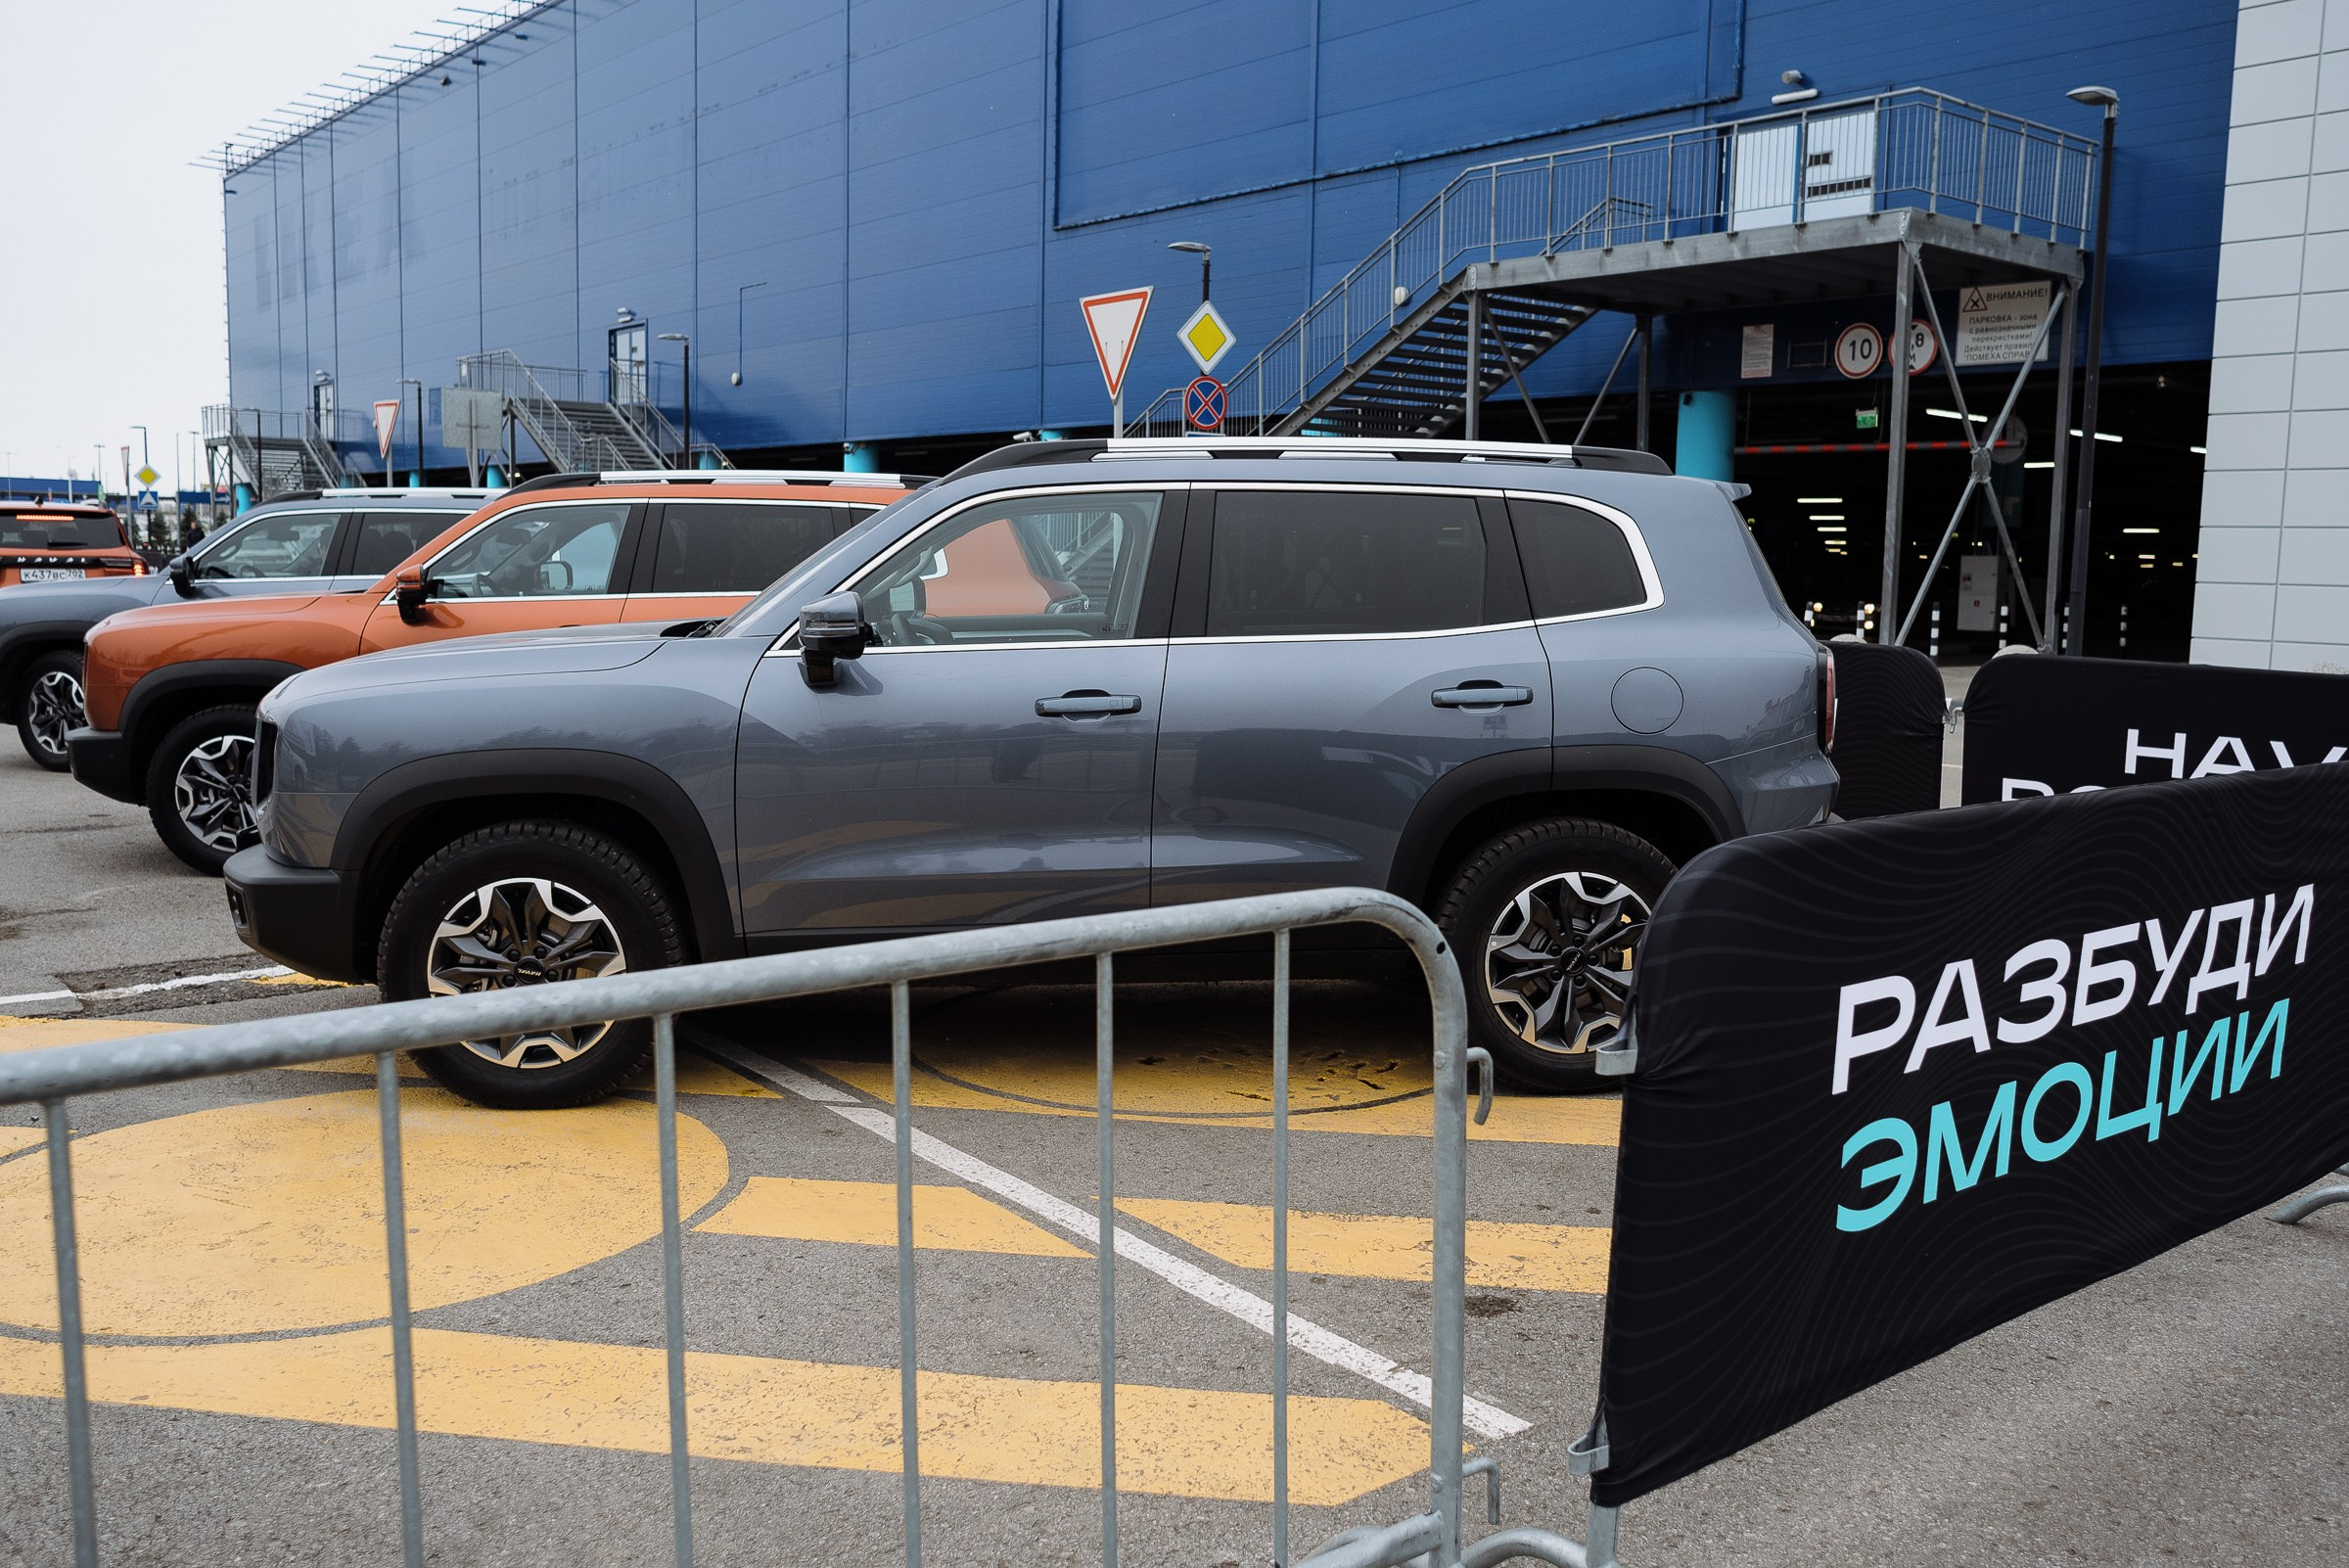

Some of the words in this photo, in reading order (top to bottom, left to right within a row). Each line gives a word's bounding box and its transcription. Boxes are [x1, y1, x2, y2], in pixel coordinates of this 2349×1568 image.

[1986, 288, 2048, 301] ВНИМАНИЕ!
[1969, 314, 2012, 325] ПАРКОВКА
[2019, 313, 2038, 322] зона
[1974, 323, 2037, 335] равнозначными
[1971, 331, 2033, 343] перекрестками!
[1849, 338, 1872, 361] 10
[1963, 345, 2003, 353] Действует
[2002, 349, 2031, 360] СПРАВ
[1832, 883, 2315, 1095] РАЗБУДИ
[1836, 998, 2290, 1232] ЭМОЦИИ
